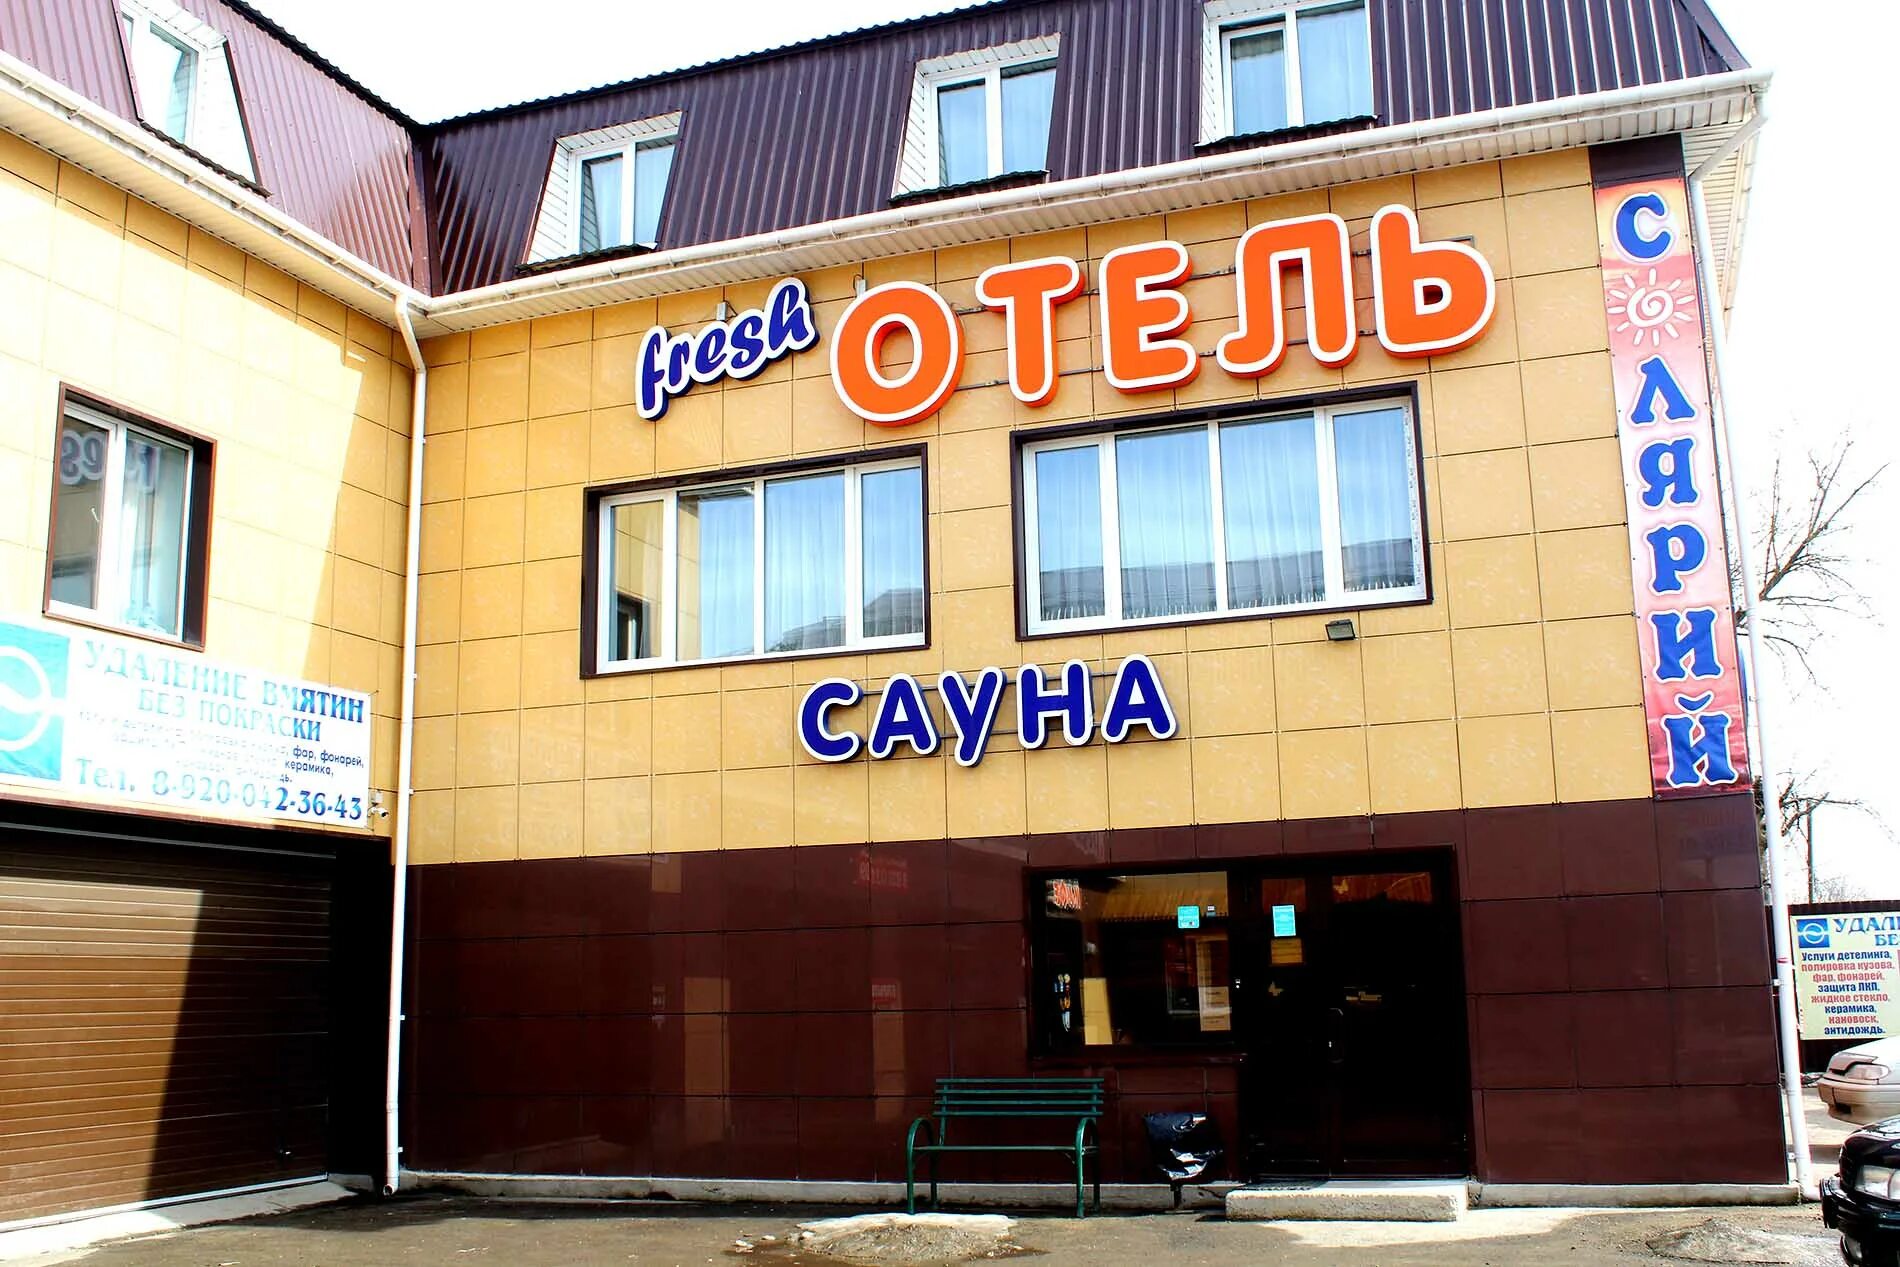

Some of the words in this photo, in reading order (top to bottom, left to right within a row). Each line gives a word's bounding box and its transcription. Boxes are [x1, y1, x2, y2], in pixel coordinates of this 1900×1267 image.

[636, 277, 820, 420] fresh
[830, 204, 1496, 426] ОТЕЛЬ
[83, 639, 248, 701] УДАЛЕНИЕ
[262, 680, 365, 724] ВМЯТИН
[137, 687, 187, 718] БЕЗ
[199, 699, 322, 742] ПОКРАСКИ
[797, 654, 1180, 767] САУНА
[320, 749, 365, 768] фонарей,
[284, 760, 334, 777] керамика,
[1874, 933, 1900, 946] БЕ
[1801, 952, 1835, 963] Услуги
[1801, 963, 1856, 973] полировка
[1818, 983, 1856, 994] защита
[1811, 994, 1852, 1005] жидкое
